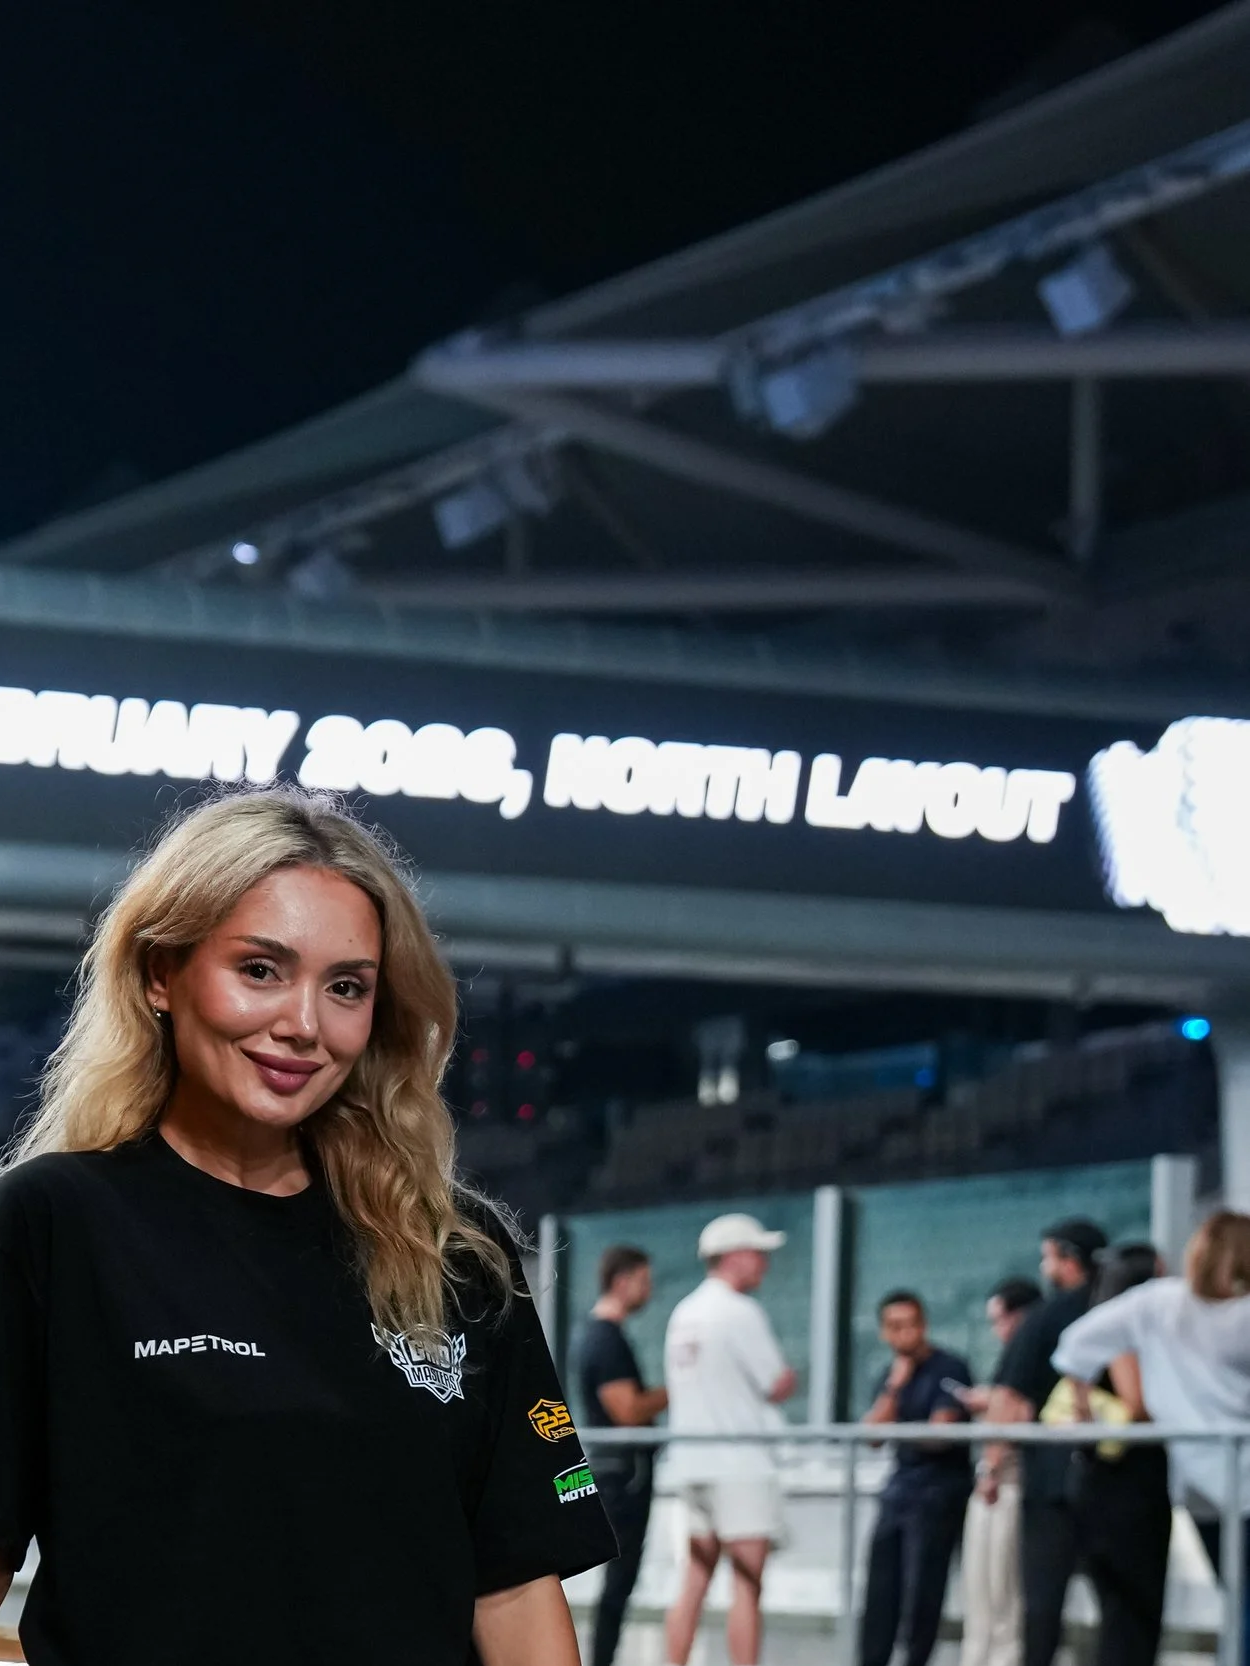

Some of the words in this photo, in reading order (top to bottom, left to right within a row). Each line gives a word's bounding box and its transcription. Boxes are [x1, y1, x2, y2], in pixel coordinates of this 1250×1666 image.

[544, 733, 801, 822] NORTH
[805, 753, 1075, 842] LAYOUT
[134, 1334, 266, 1359] MAPETROL
[410, 1366, 457, 1391] MASTERS
[558, 1484, 599, 1504] MOTO
